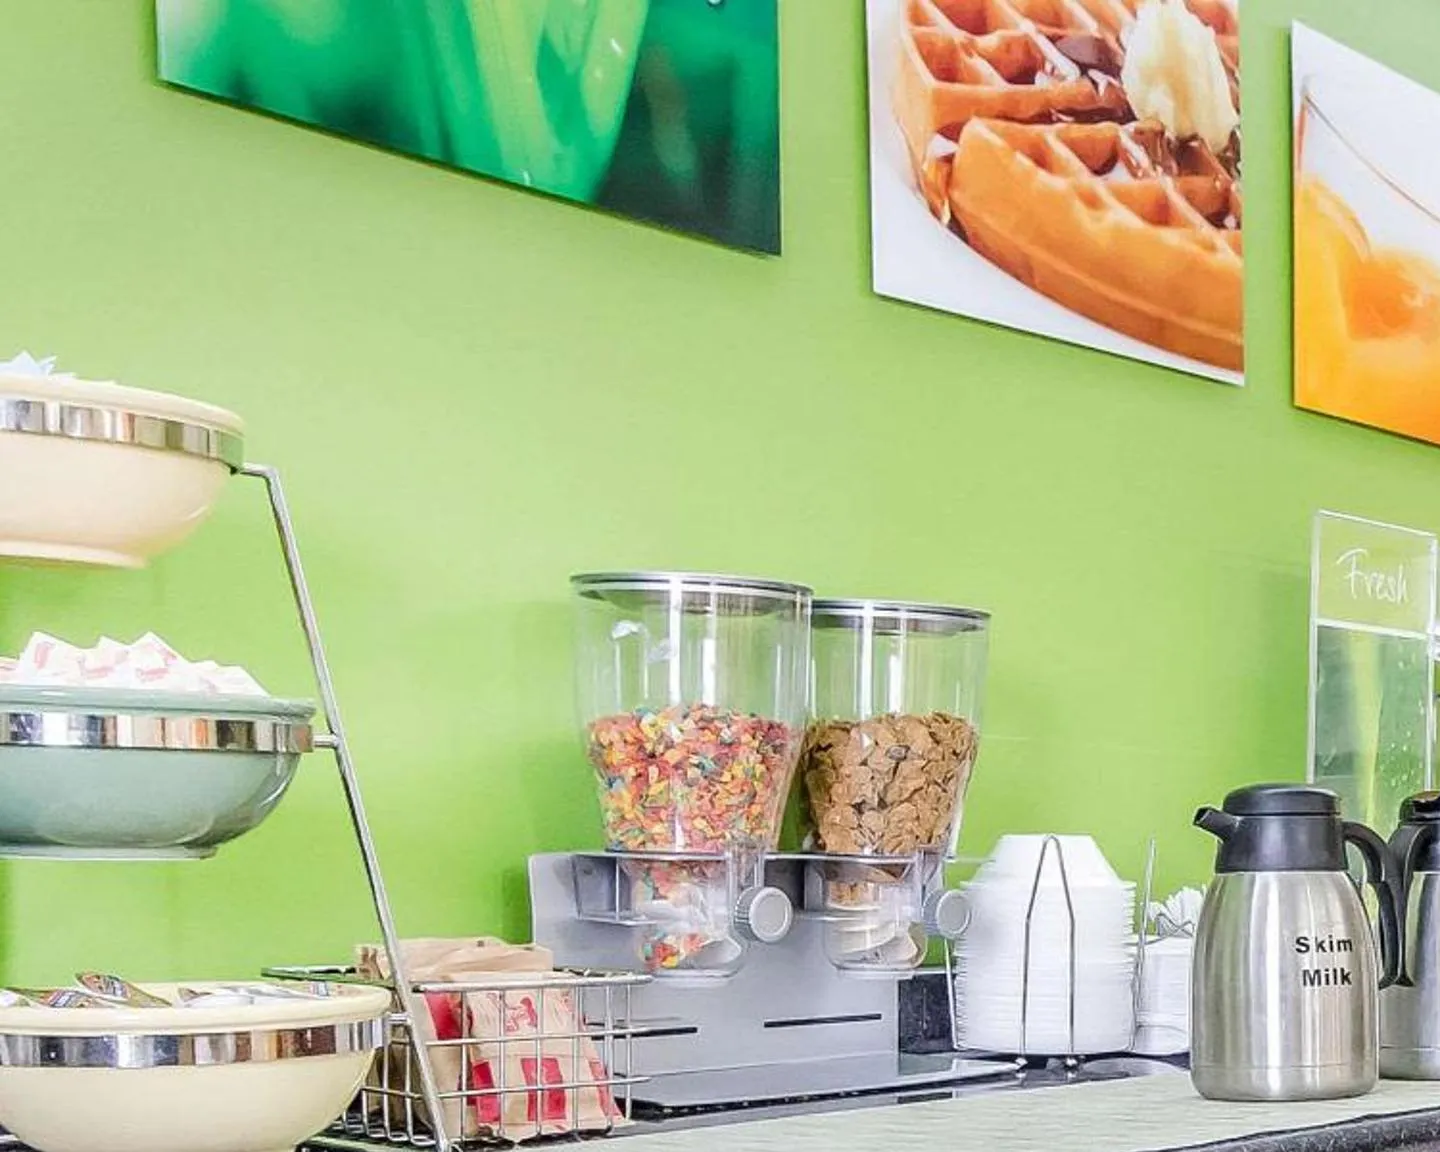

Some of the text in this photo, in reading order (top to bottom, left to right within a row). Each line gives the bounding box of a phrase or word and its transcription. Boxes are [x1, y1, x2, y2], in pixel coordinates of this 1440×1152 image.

[1336, 548, 1408, 605] Fresh
[1295, 934, 1353, 954] Skim
[1302, 967, 1352, 987] Milk
